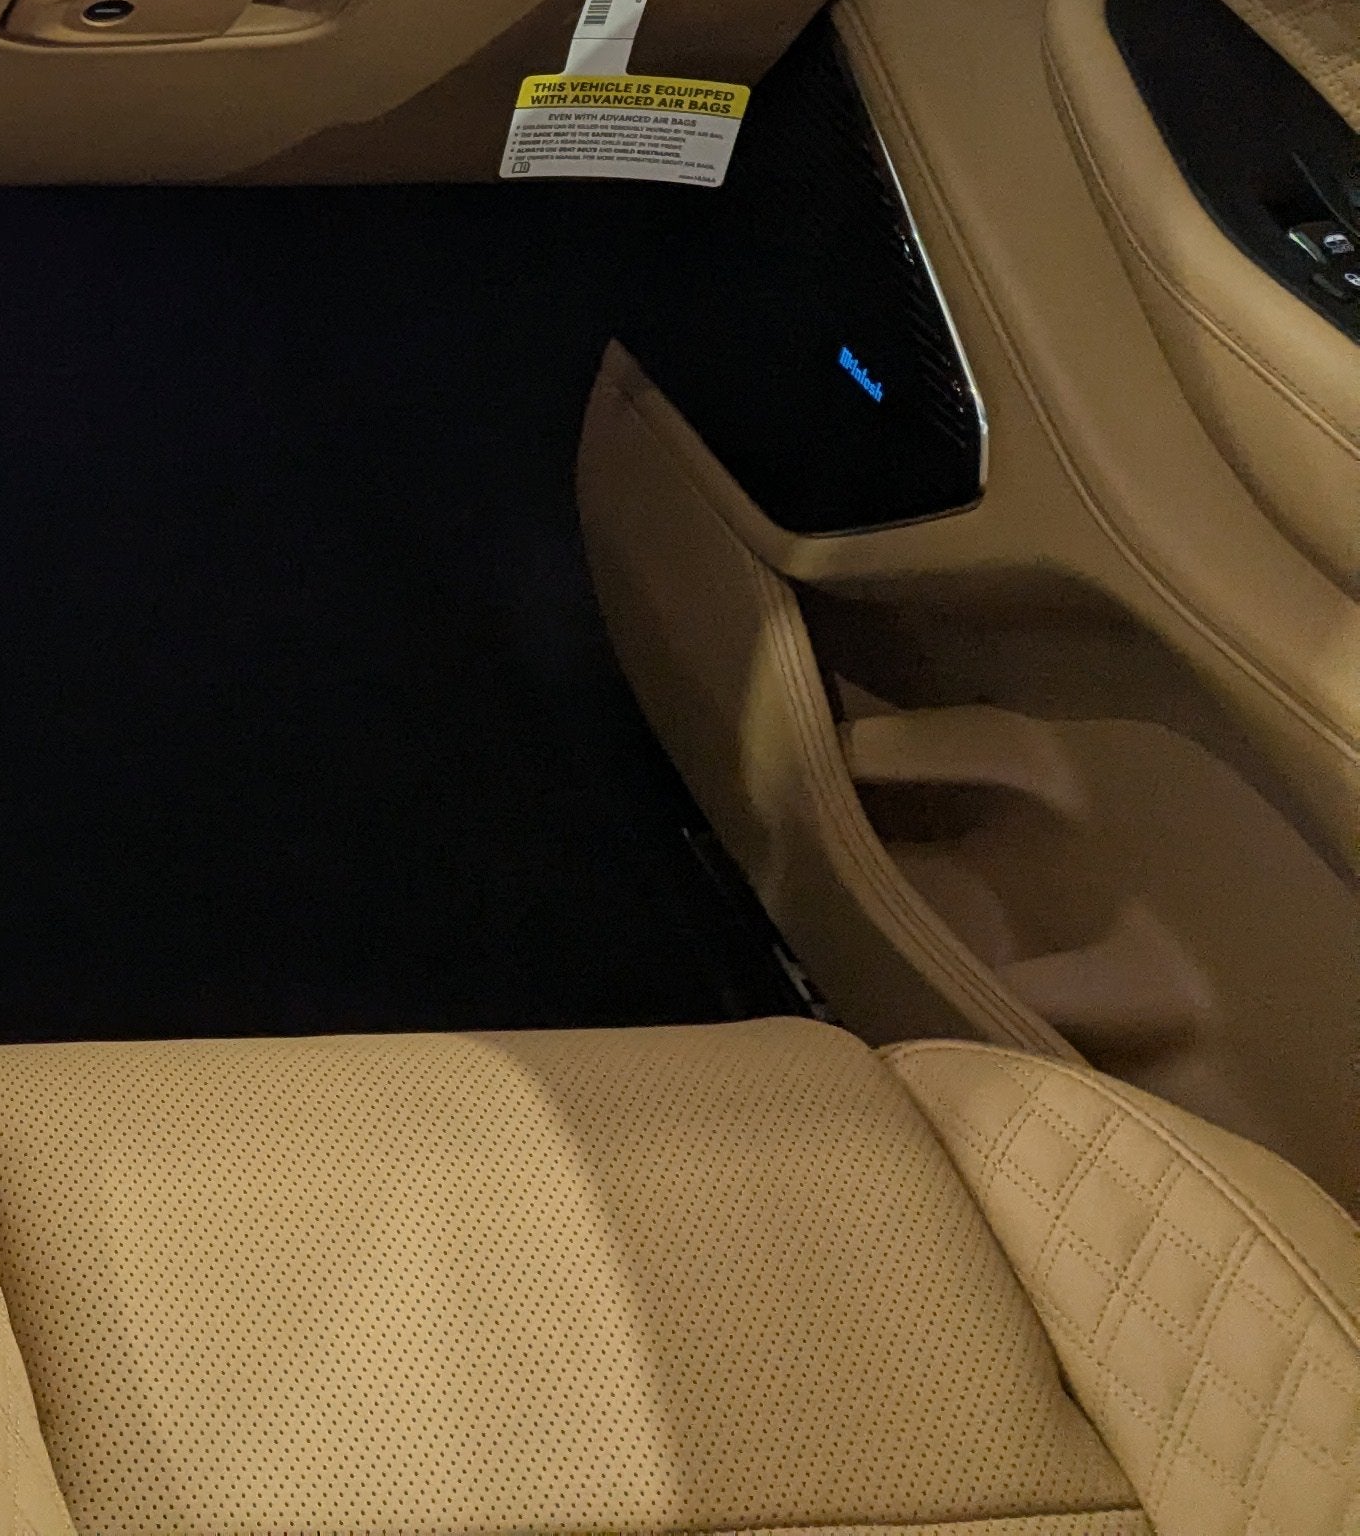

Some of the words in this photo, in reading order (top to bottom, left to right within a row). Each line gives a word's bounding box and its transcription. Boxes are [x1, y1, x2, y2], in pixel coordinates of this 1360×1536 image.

[534, 82, 567, 93] THIS
[571, 82, 634, 93] VEHICLE
[637, 83, 652, 94] IS
[655, 84, 736, 101] EQUIPPED
[530, 94, 568, 105] WITH
[570, 94, 655, 106] ADVANCED
[657, 98, 685, 109] AIR
[688, 100, 732, 114] BAGS
[548, 113, 572, 121] EVEN
[574, 113, 598, 121] WITH
[599, 114, 651, 123] ADVANCED
[653, 116, 669, 124] AIR
[671, 118, 697, 127] BAGS
[838, 346, 883, 403] McIntosh
